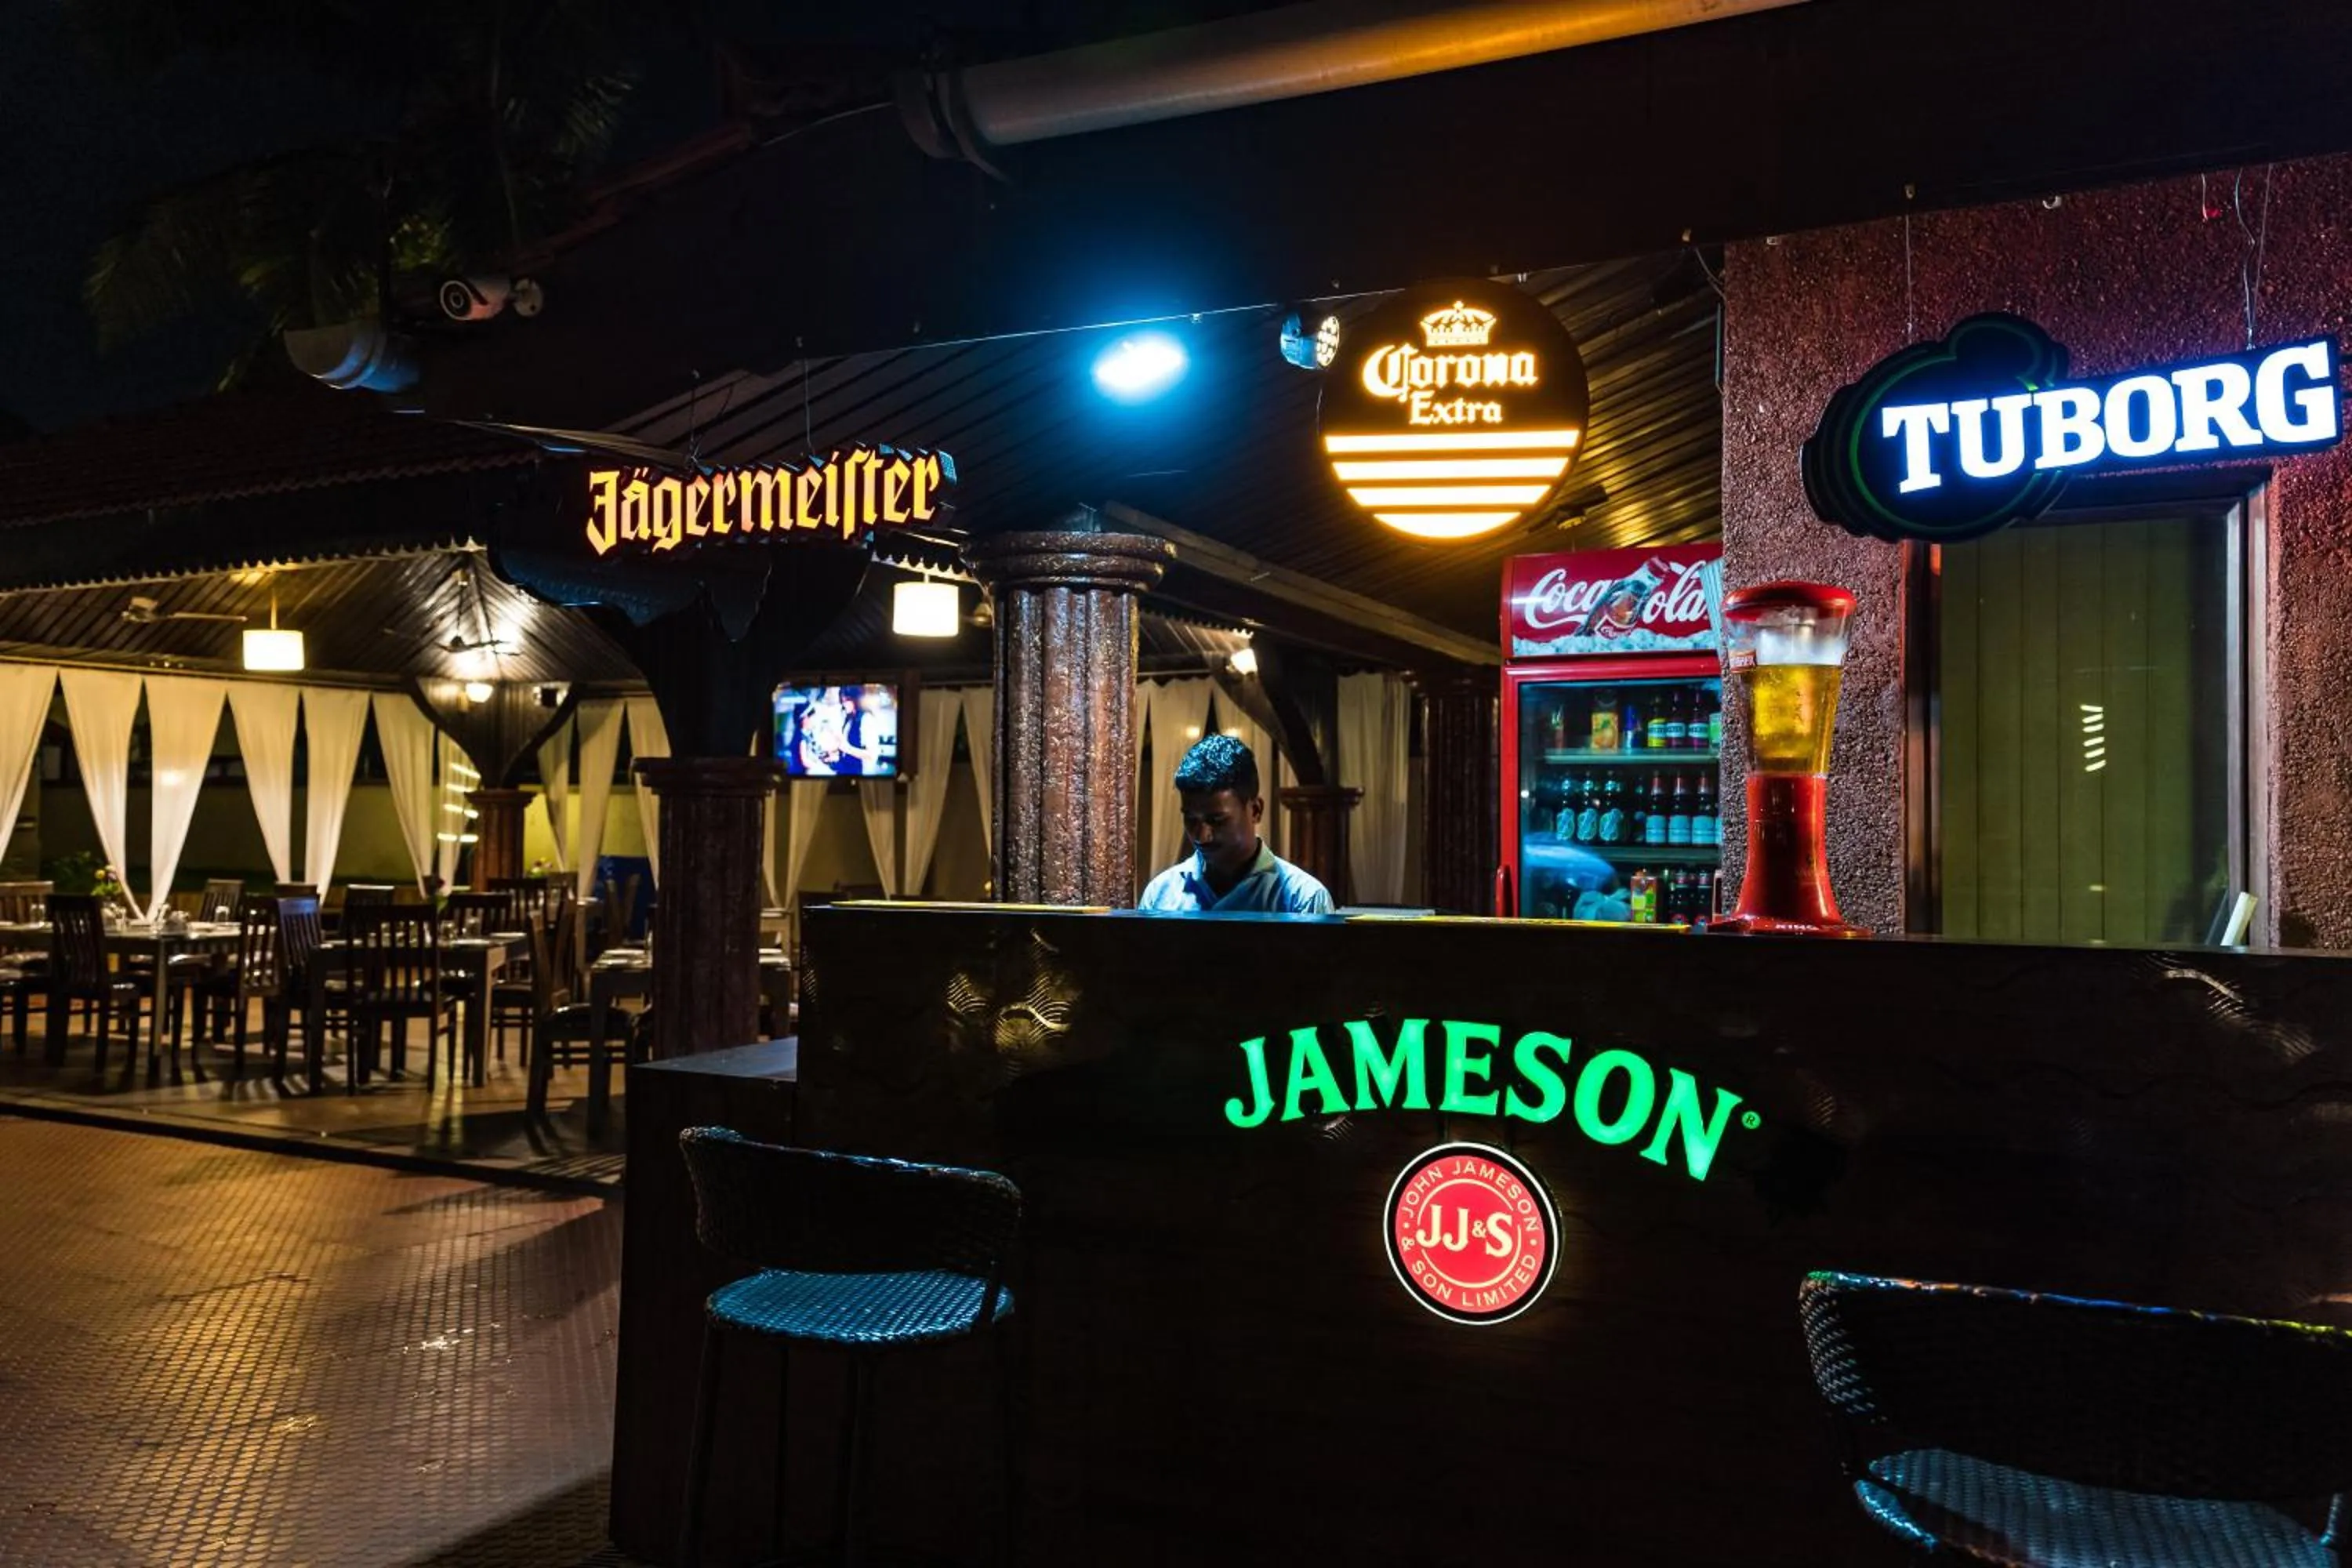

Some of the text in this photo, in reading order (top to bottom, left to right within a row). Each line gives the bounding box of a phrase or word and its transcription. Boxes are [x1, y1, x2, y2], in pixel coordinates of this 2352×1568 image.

[1361, 343, 1539, 402] Corona
[1408, 390, 1504, 425] Extra
[1881, 340, 2338, 495] TUBORG
[586, 448, 941, 556] Jägermeister
[1225, 1018, 1743, 1181] JAMESON
[1401, 1160, 1541, 1232] JOHN JAMESON
[1415, 1203, 1513, 1258] JJ&S
[1412, 1259, 1454, 1301] SON
[1461, 1254, 1537, 1308] LIMITED
